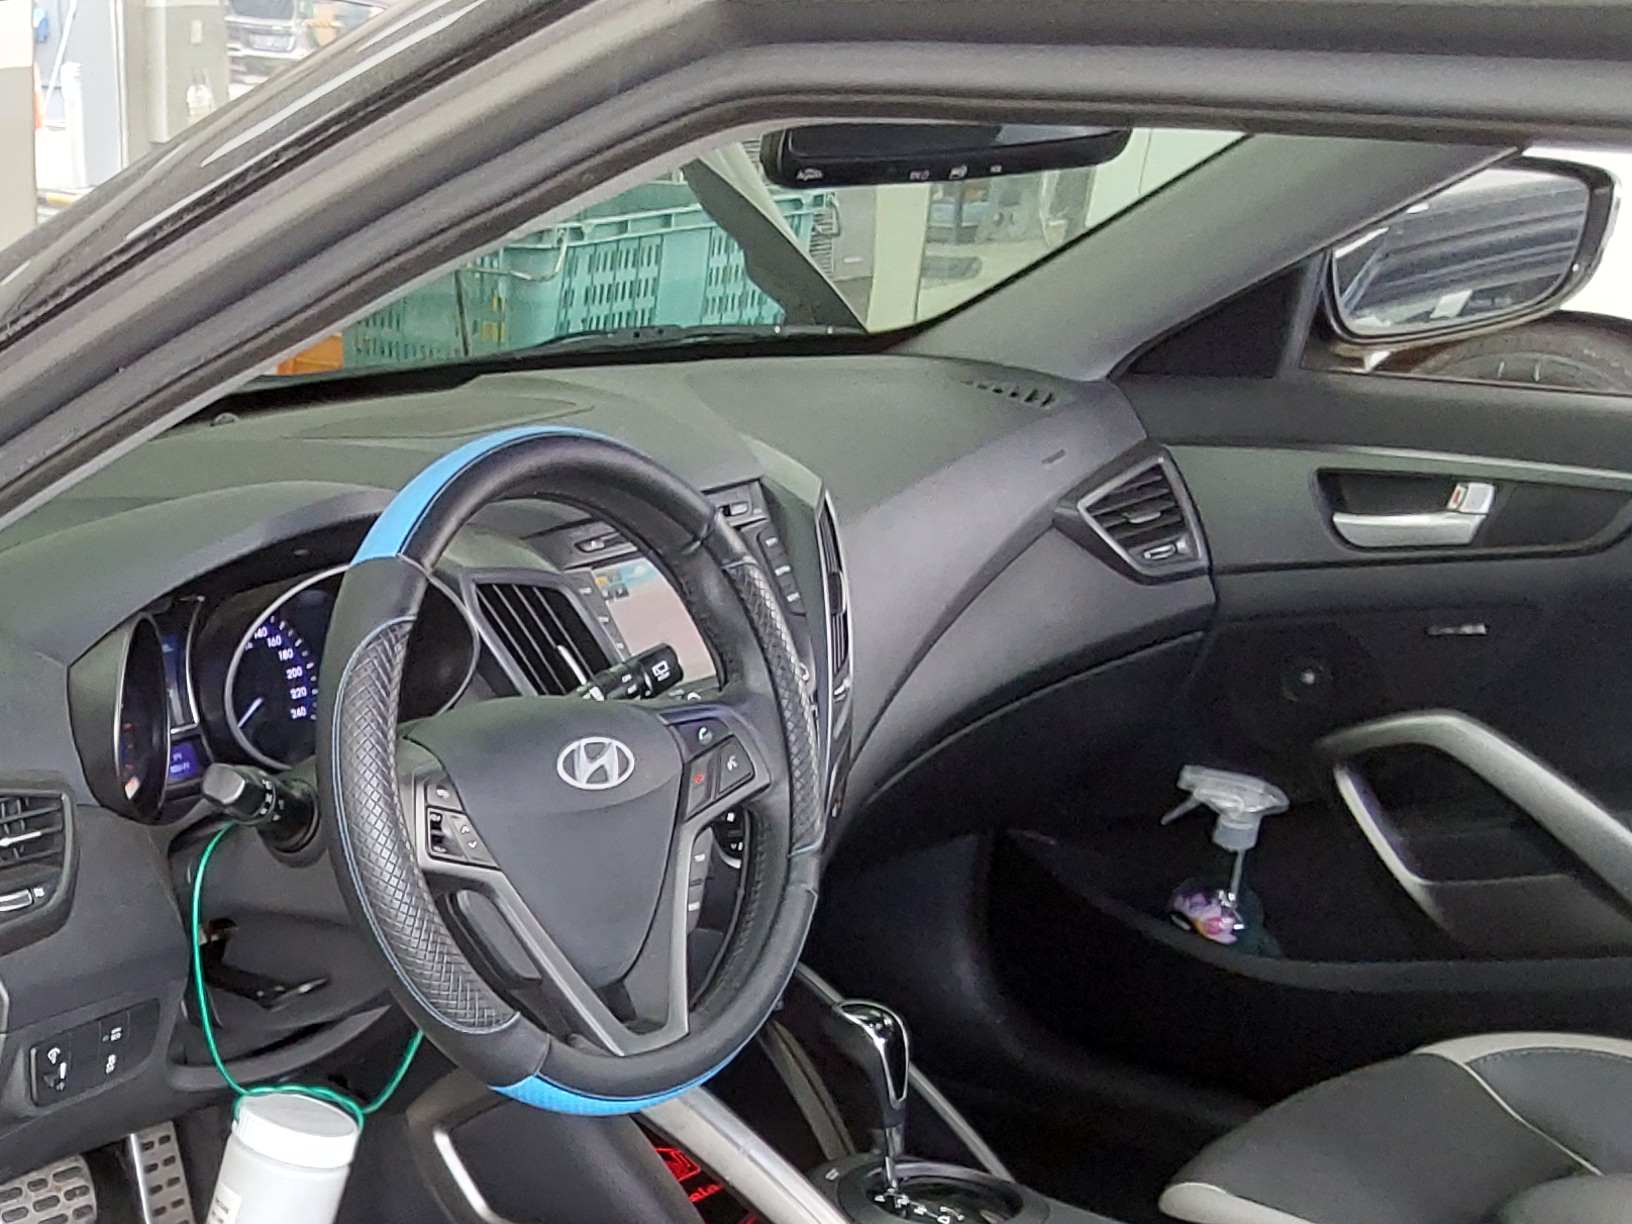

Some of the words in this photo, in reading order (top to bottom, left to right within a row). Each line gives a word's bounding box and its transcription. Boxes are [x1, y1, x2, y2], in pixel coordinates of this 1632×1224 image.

[267, 635, 281, 648] 160
[278, 648, 293, 661] 180
[287, 666, 302, 679] 200
[290, 687, 306, 699] 220
[290, 707, 306, 719] 240
